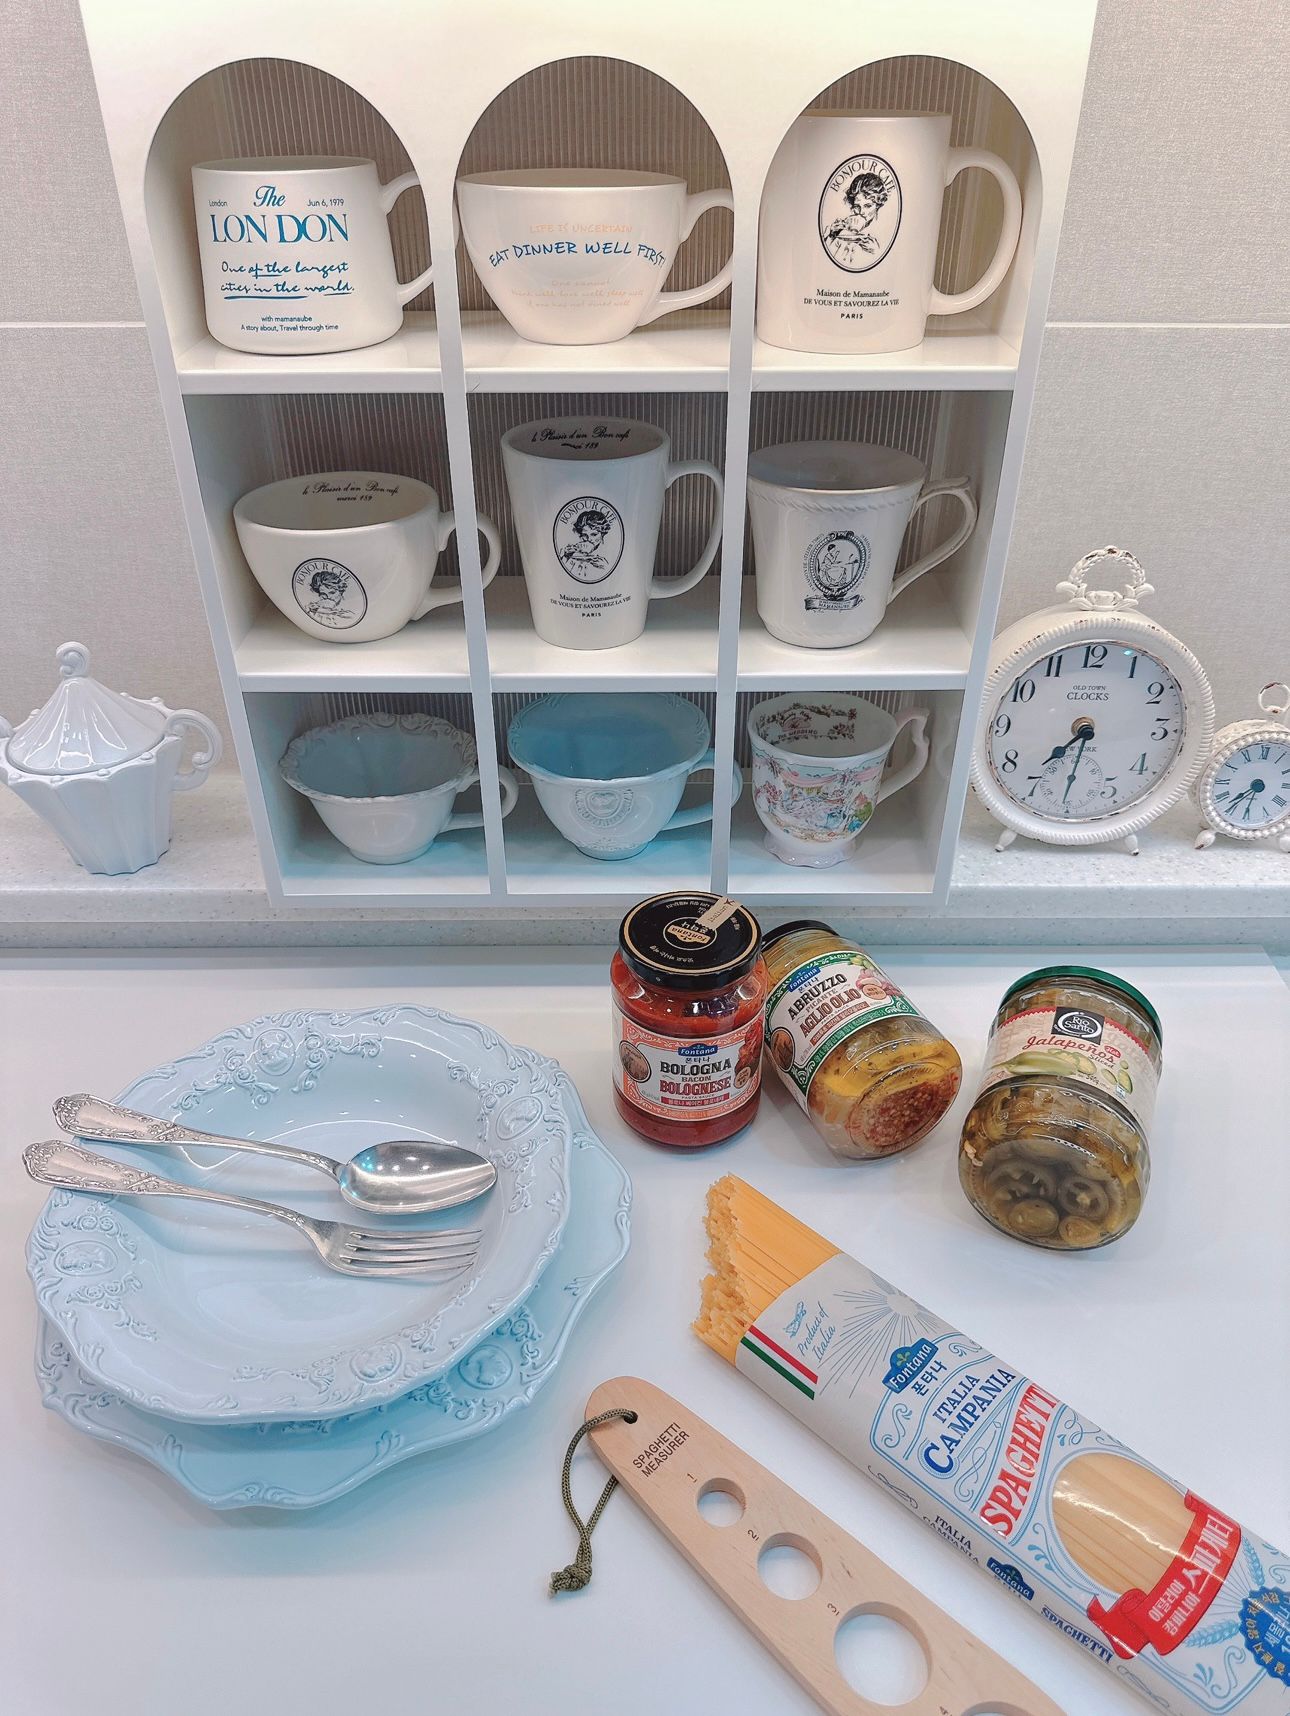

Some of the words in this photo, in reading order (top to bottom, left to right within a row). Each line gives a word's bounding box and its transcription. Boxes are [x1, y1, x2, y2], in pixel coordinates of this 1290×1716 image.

[830, 160, 877, 192] BONJOUR
[254, 186, 285, 206] The
[322, 199, 328, 207] 6,
[530, 223, 553, 233] LIFE
[573, 223, 632, 232] UNCERTAIN
[489, 249, 509, 267] EAT
[512, 242, 578, 258] DINNER
[585, 242, 632, 254] WELL
[222, 262, 245, 273] One
[248, 264, 262, 279] of
[265, 262, 291, 273] the
[296, 262, 349, 278] largest
[221, 283, 250, 293] cities
[254, 284, 271, 292] in
[274, 281, 300, 292] the
[304, 280, 354, 293] world.
[817, 289, 841, 297] Maison
[260, 324, 278, 332] about,
[300, 324, 324, 332] through
[592, 426, 613, 438] Bon
[560, 500, 598, 524] BONJOUR
[296, 563, 328, 585] BONJOUR
[1044, 655, 1063, 677] 11
[1081, 645, 1108, 669] 12
[1128, 656, 1138, 678] 1
[1010, 679, 1035, 702] 10
[1067, 692, 1109, 701] CLOCKS
[1145, 682, 1164, 704] 2
[995, 714, 1011, 737] 9
[1151, 718, 1170, 740] 3
[1002, 749, 1018, 773] 8
[1128, 752, 1148, 775] 4
[1027, 776, 1042, 796] 7
[1100, 776, 1117, 799] 5
[672, 927, 707, 941] Fontana
[790, 968, 817, 990] Fontana
[788, 974, 847, 1020] ABRUZZO
[806, 988, 838, 1012] PICANTE
[800, 1002, 833, 1038] AGLIO
[830, 988, 861, 1009] OLIO
[1071, 1016, 1090, 1026] Rio
[1064, 1021, 1094, 1034] Santo
[1022, 1036, 1115, 1063] Jalapeños
[660, 1058, 731, 1076] BOLOGNA
[1089, 1054, 1114, 1069] Sliced
[660, 1076, 731, 1095] BOLOGNESE
[797, 1316, 821, 1356] Product
[820, 1301, 830, 1318] of
[812, 1326, 835, 1363] Italia
[890, 1344, 932, 1388] Fontana
[912, 1360, 947, 1396] 폰타나
[932, 1374, 980, 1423] ITALIA
[924, 1369, 1016, 1473] CAMPANIA
[632, 1422, 681, 1469] SPAGHETTI
[642, 1431, 690, 1477] MEASURER
[687, 1473, 696, 1482] 1
[747, 1529, 758, 1540] 2
[934, 1515, 972, 1550] ITALIA
[1182, 1514, 1233, 1594] 스파게티
[990, 1562, 1030, 1597] Fontana
[827, 1603, 839, 1615] 3
[1148, 1579, 1185, 1622] 이탈리아
[1162, 1591, 1200, 1636] 캄파니아
[1042, 1607, 1114, 1664] SPAGHETTI
